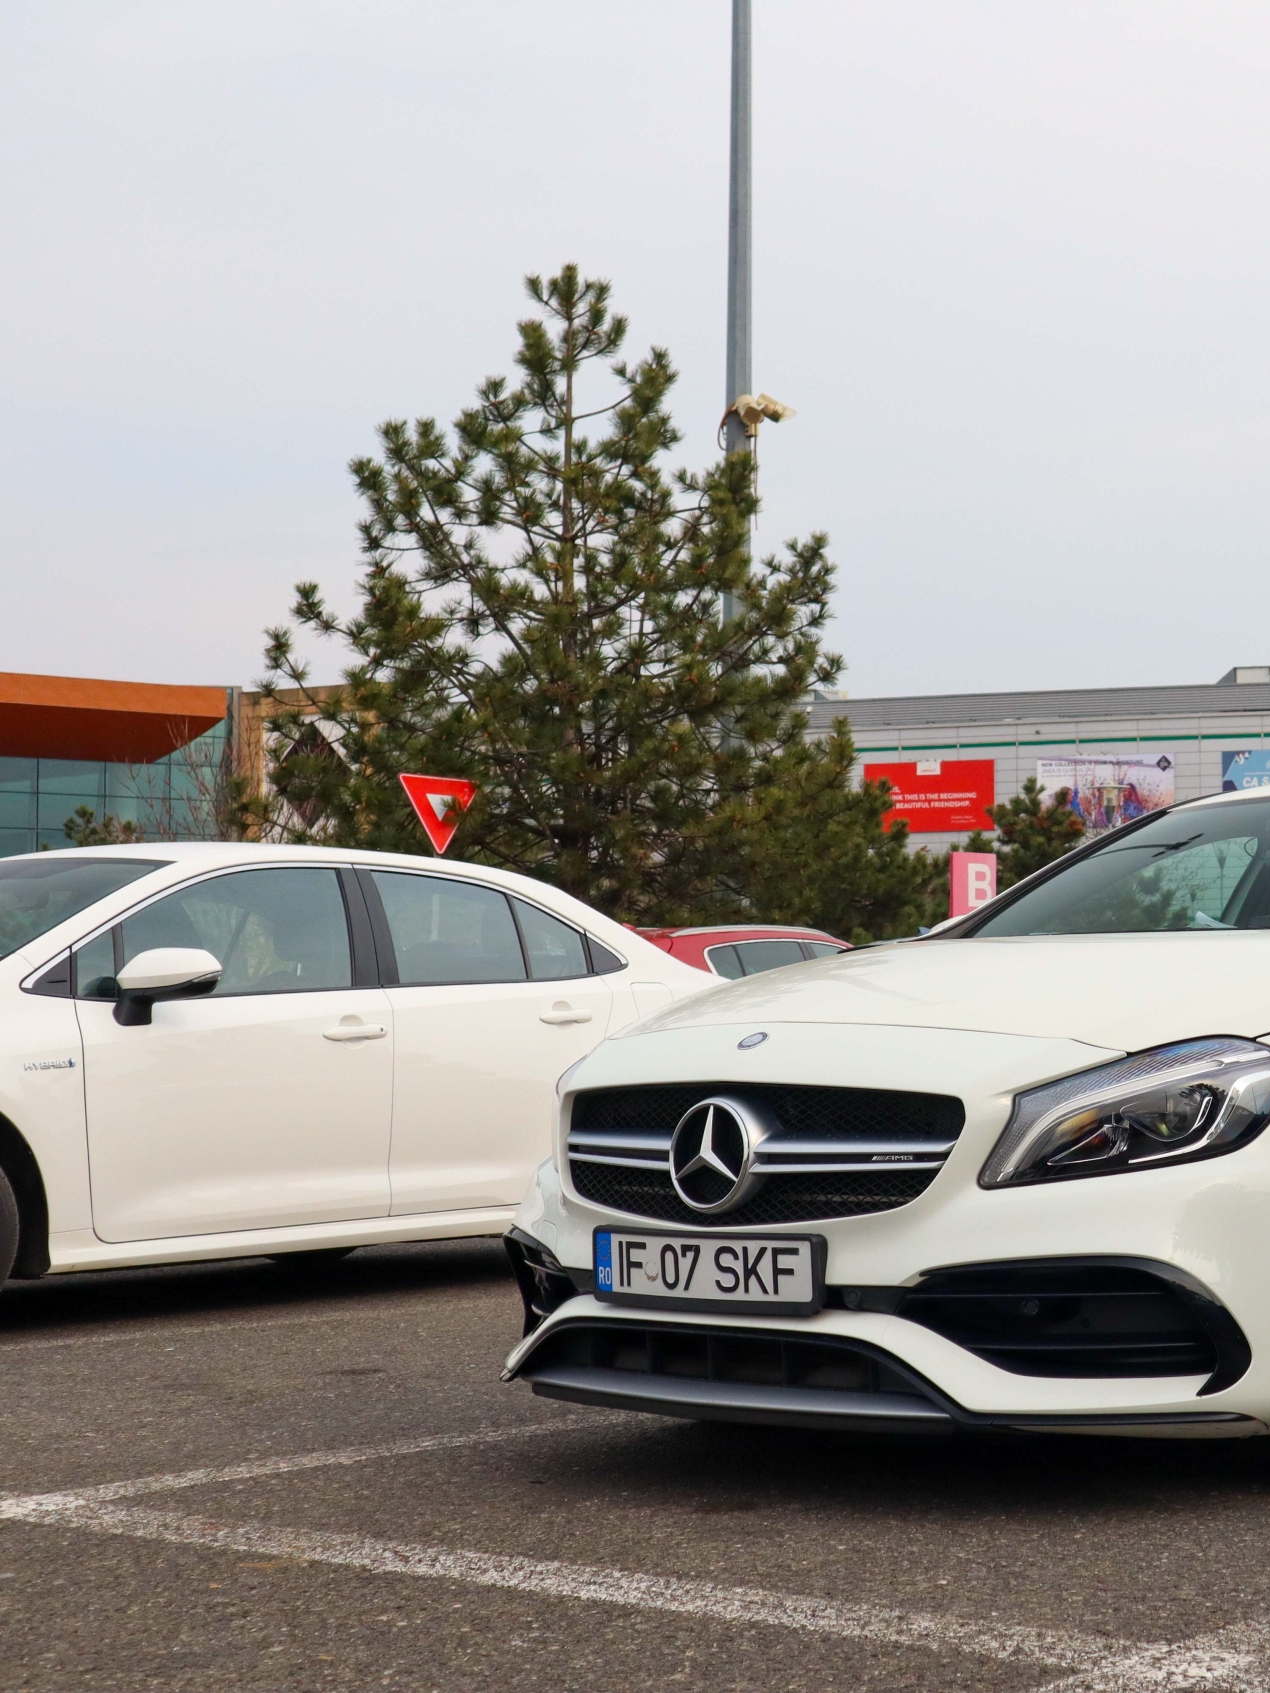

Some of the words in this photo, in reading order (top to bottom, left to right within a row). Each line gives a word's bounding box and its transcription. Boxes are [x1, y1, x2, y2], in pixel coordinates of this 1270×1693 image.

[1243, 776, 1259, 787] CA
[904, 793, 918, 801] THIS
[940, 792, 977, 800] BEGINNING
[895, 801, 930, 809] BEAUTIFUL
[967, 863, 992, 907] B
[598, 1266, 612, 1285] RO
[618, 1240, 648, 1288] IF
[660, 1243, 701, 1291] 07
[713, 1245, 800, 1296] SKF
